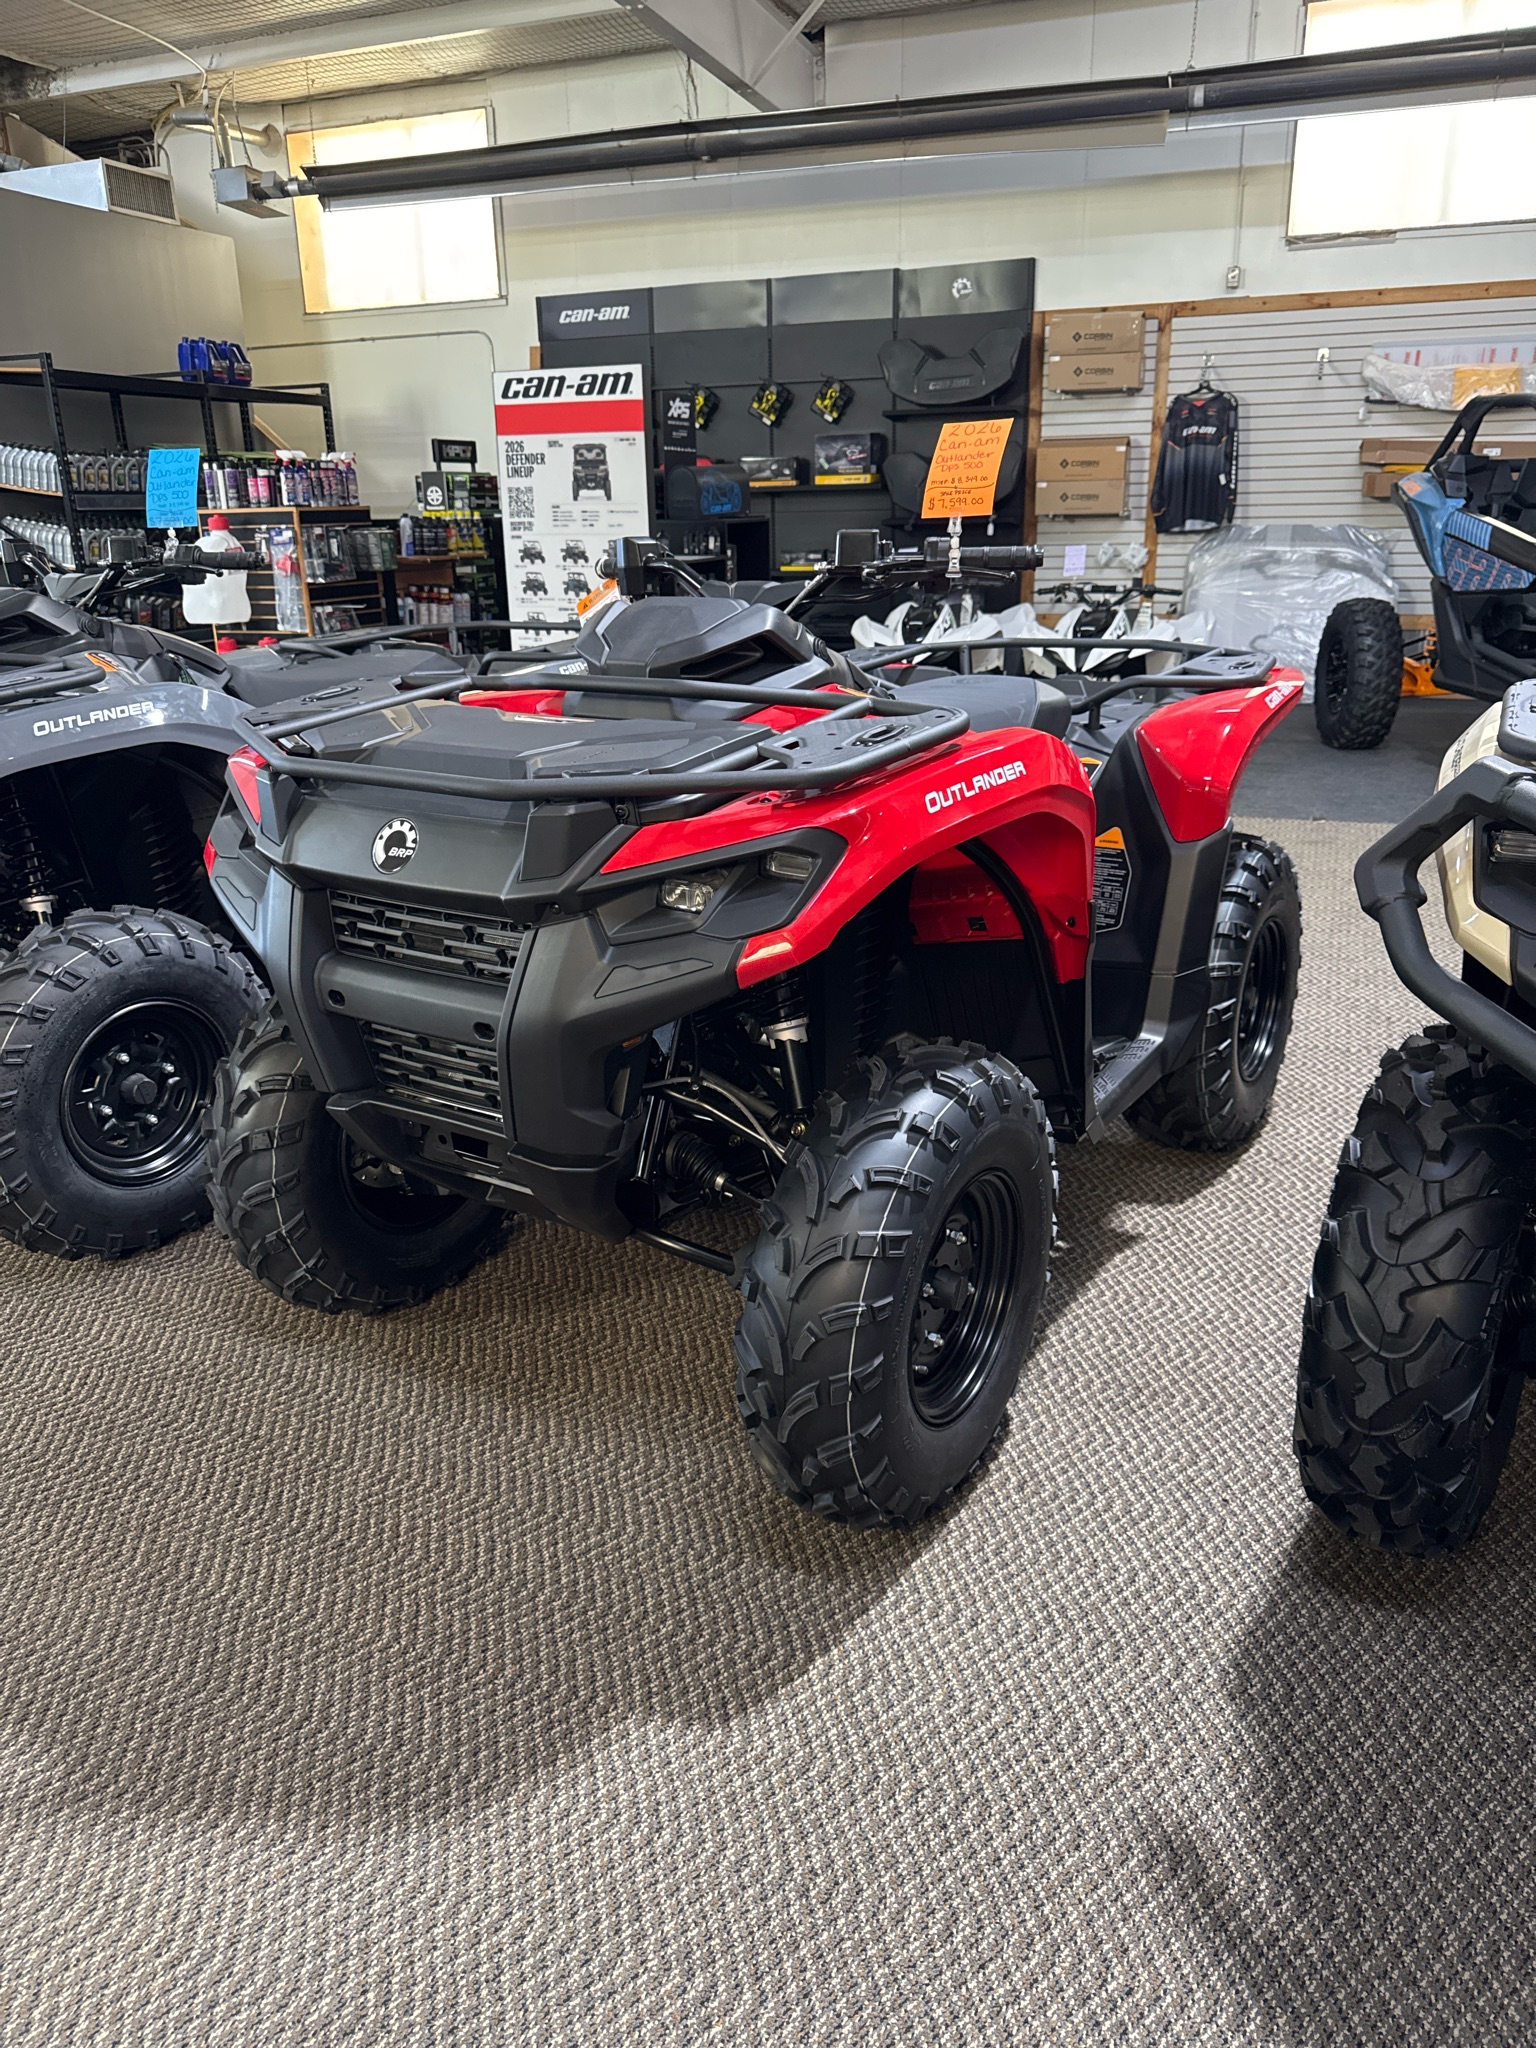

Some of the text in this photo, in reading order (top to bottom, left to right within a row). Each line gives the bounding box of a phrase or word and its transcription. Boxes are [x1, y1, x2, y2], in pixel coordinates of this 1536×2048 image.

[559, 305, 630, 324] can-am
[501, 372, 633, 399] can-am
[667, 397, 691, 419] XPS
[948, 422, 1002, 437] 2026
[505, 440, 524, 453] 2026
[939, 436, 1000, 451] Can-am
[151, 450, 194, 465] 2026
[505, 452, 546, 466] DEFENDER
[935, 450, 995, 465] Outlander
[506, 465, 535, 478] LINEUP
[963, 461, 983, 470] 500
[171, 490, 189, 499] 500
[33, 701, 154, 737] OUTLANDER
[925, 760, 1027, 814] OUTLANDER
[388, 846, 414, 858] BRP
